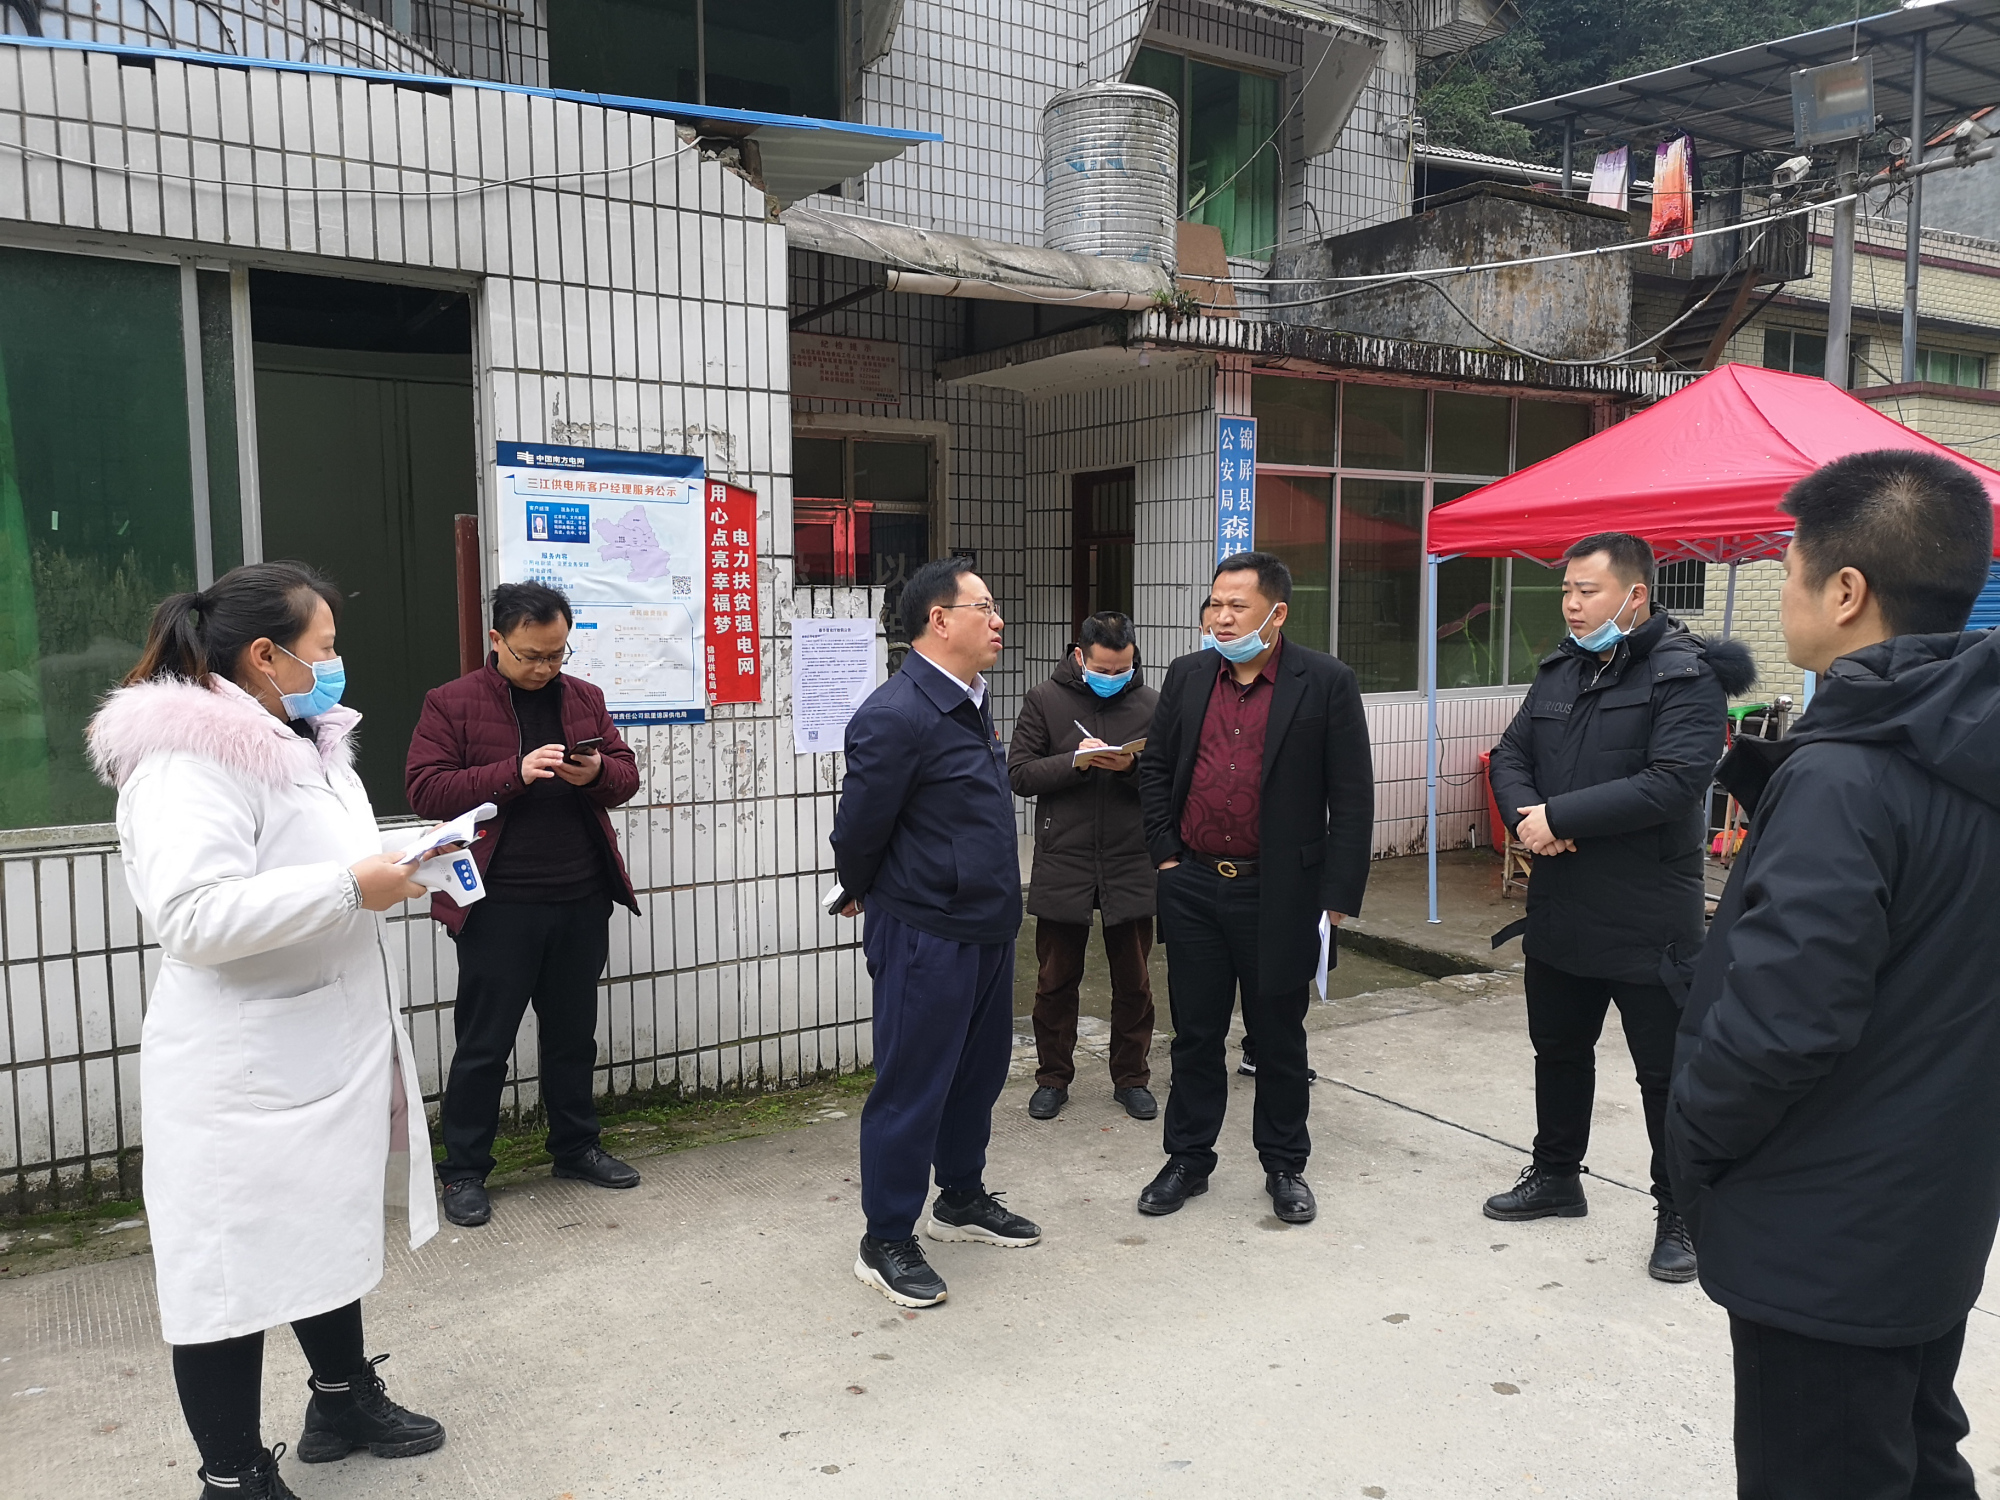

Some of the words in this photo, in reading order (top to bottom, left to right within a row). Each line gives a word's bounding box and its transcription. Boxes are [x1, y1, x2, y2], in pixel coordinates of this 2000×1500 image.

[527, 477, 677, 497] 三江供电所客户经理服务公示
[536, 454, 585, 466] 中国南方电网
[1221, 427, 1235, 511] 公安局
[1238, 427, 1253, 512] 锦屏县
[710, 484, 732, 635] 用心点亮幸福梦
[732, 528, 755, 676] 电力扶贫强电网
